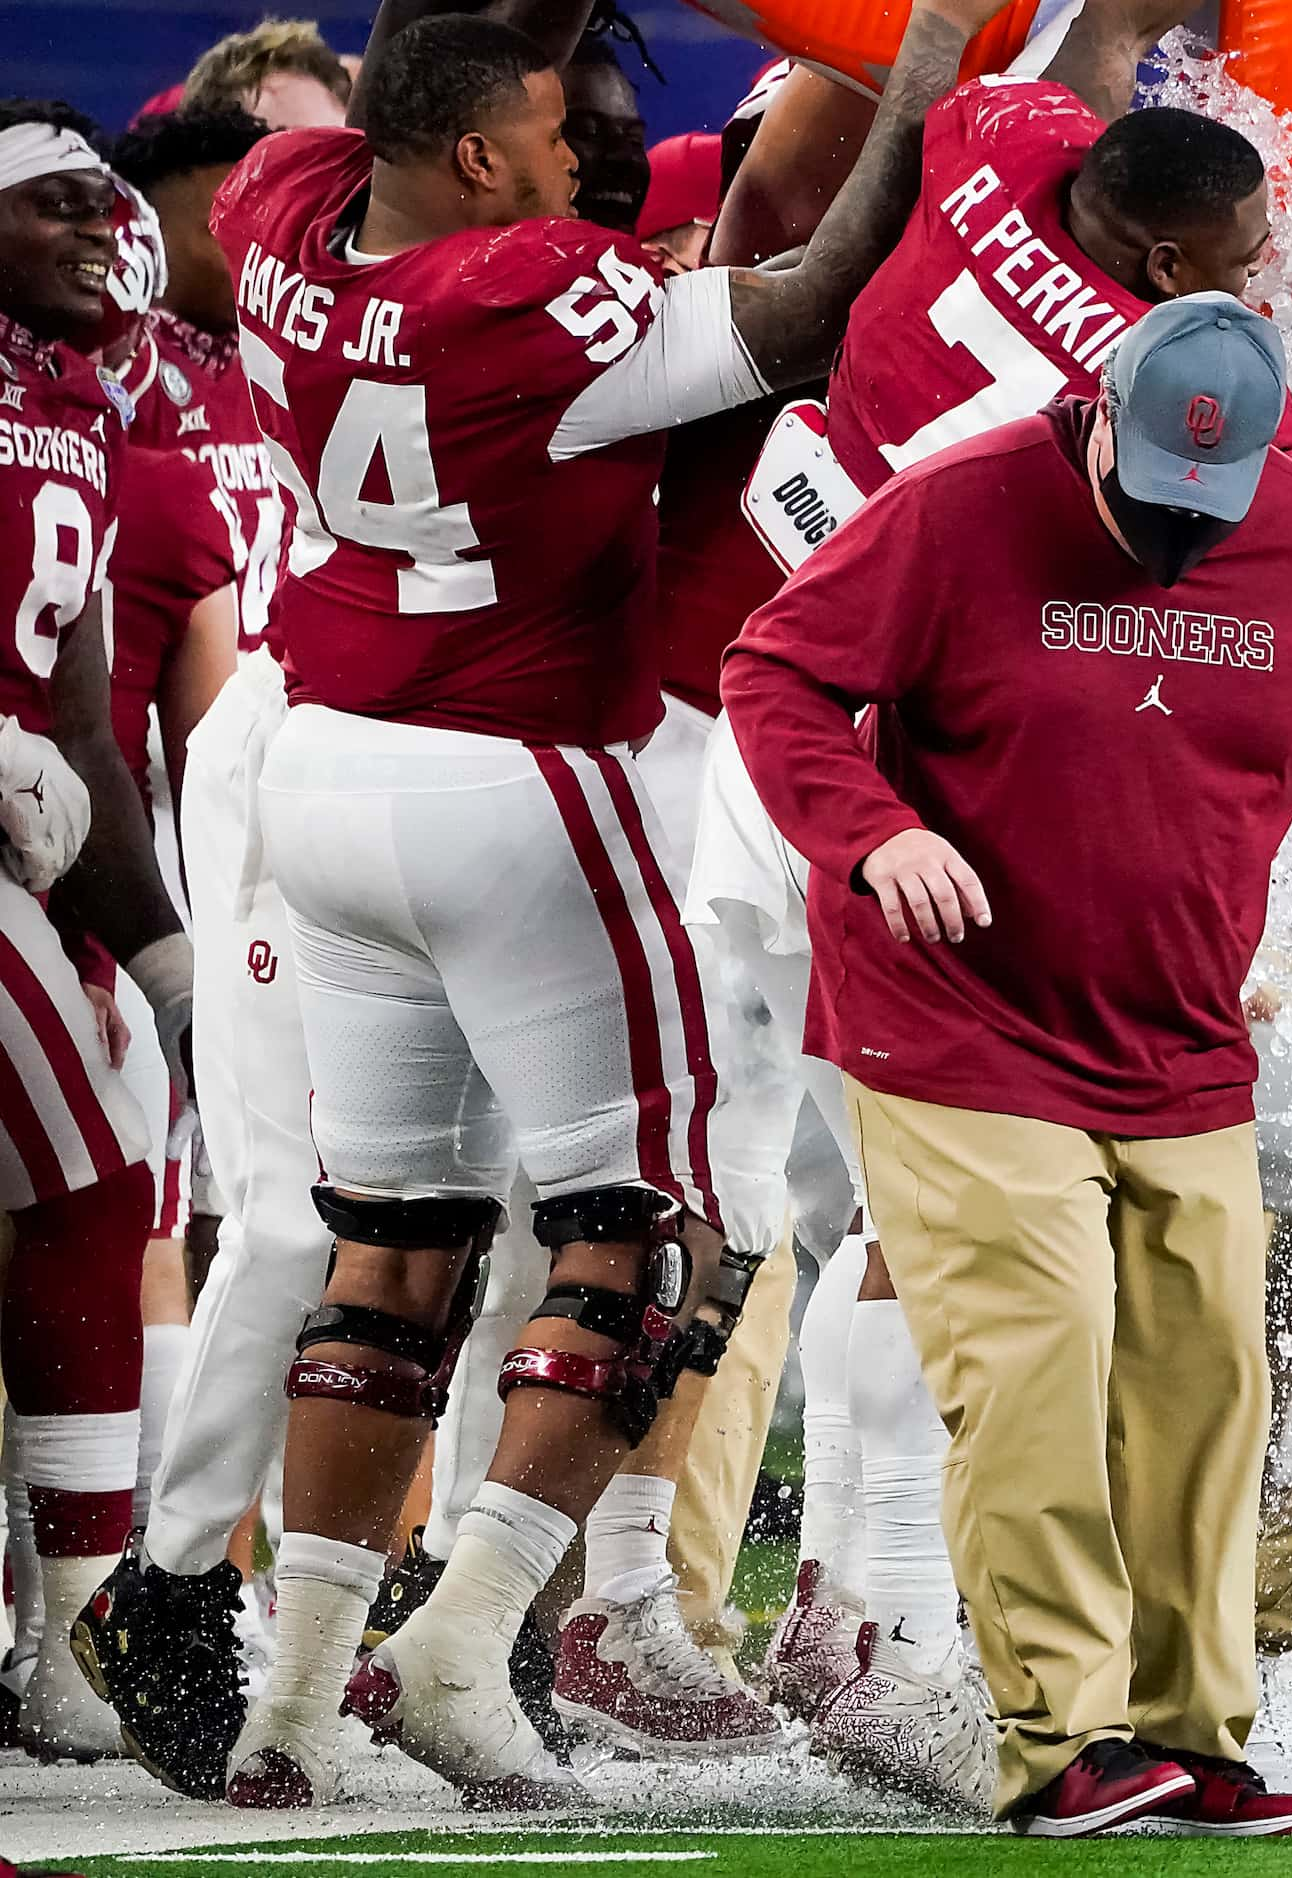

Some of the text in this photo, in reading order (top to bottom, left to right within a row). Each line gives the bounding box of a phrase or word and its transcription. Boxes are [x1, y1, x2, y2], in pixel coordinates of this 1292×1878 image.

[940, 164, 1001, 237] R.
[238, 240, 411, 367] HAYES JR.
[544, 244, 667, 363] 54
[878, 267, 1069, 475] 7
[1187, 394, 1225, 449] OU
[239, 325, 498, 614] 54
[772, 472, 837, 551] DOUG
[1041, 600, 1274, 671] SOONERS
[247, 939, 278, 984] OU
